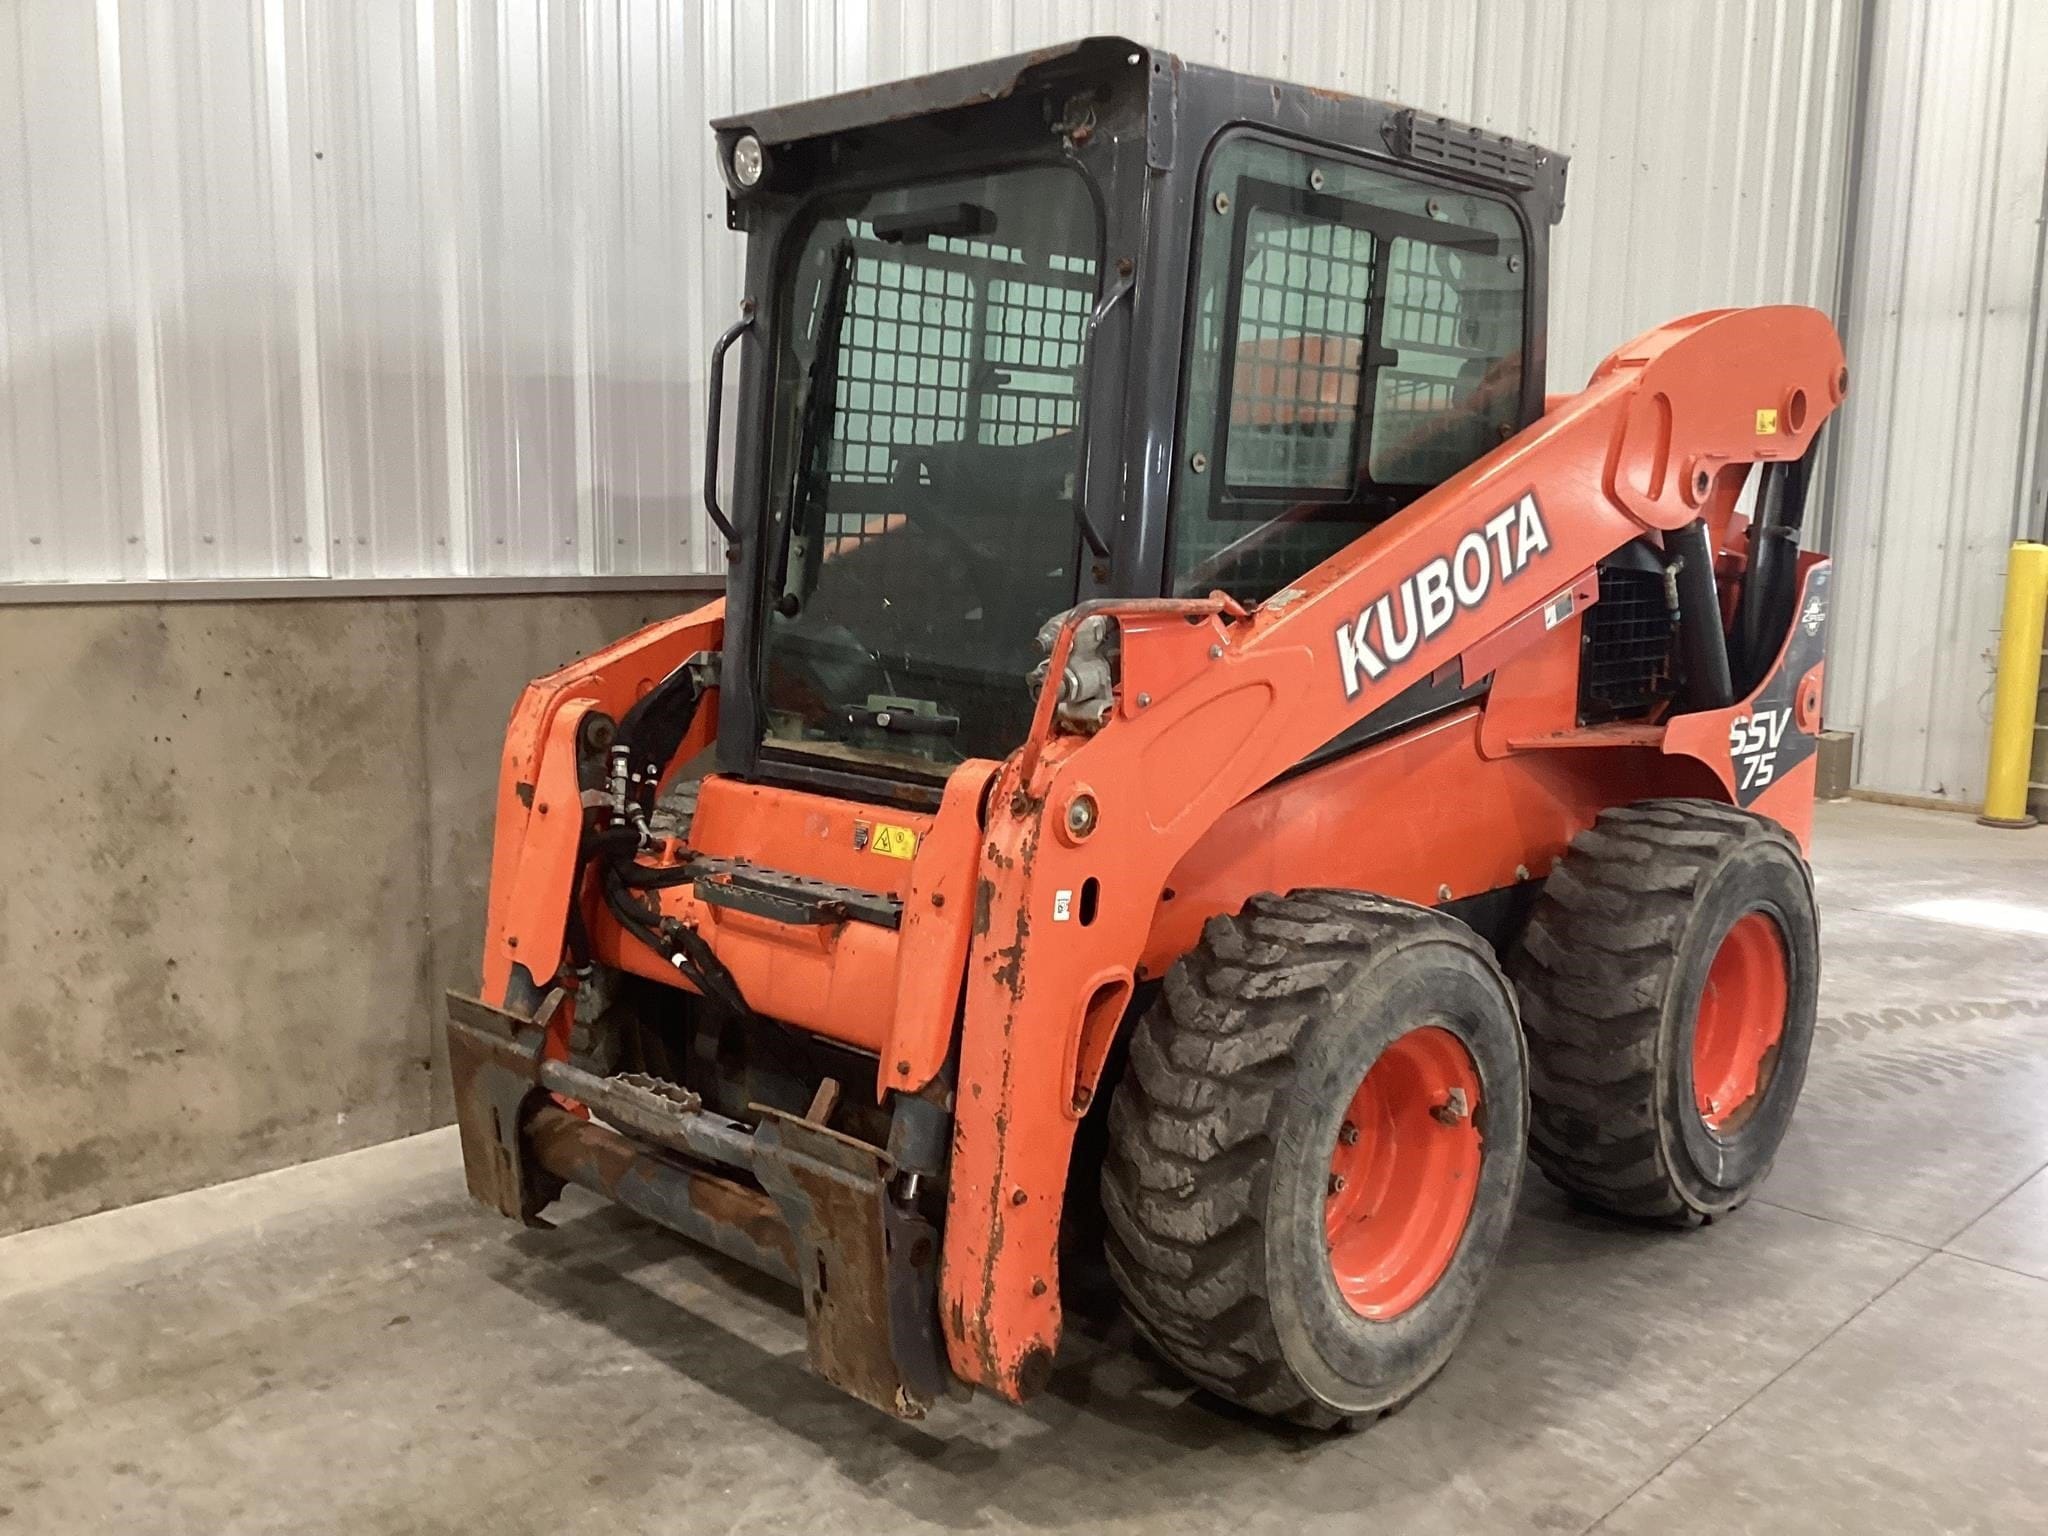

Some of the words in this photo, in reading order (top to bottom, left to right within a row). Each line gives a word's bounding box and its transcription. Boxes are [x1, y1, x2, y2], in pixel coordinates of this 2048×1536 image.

[1335, 493, 1550, 698] KUBOTA
[1730, 707, 1792, 757] SSV
[1740, 752, 1777, 790] 75
